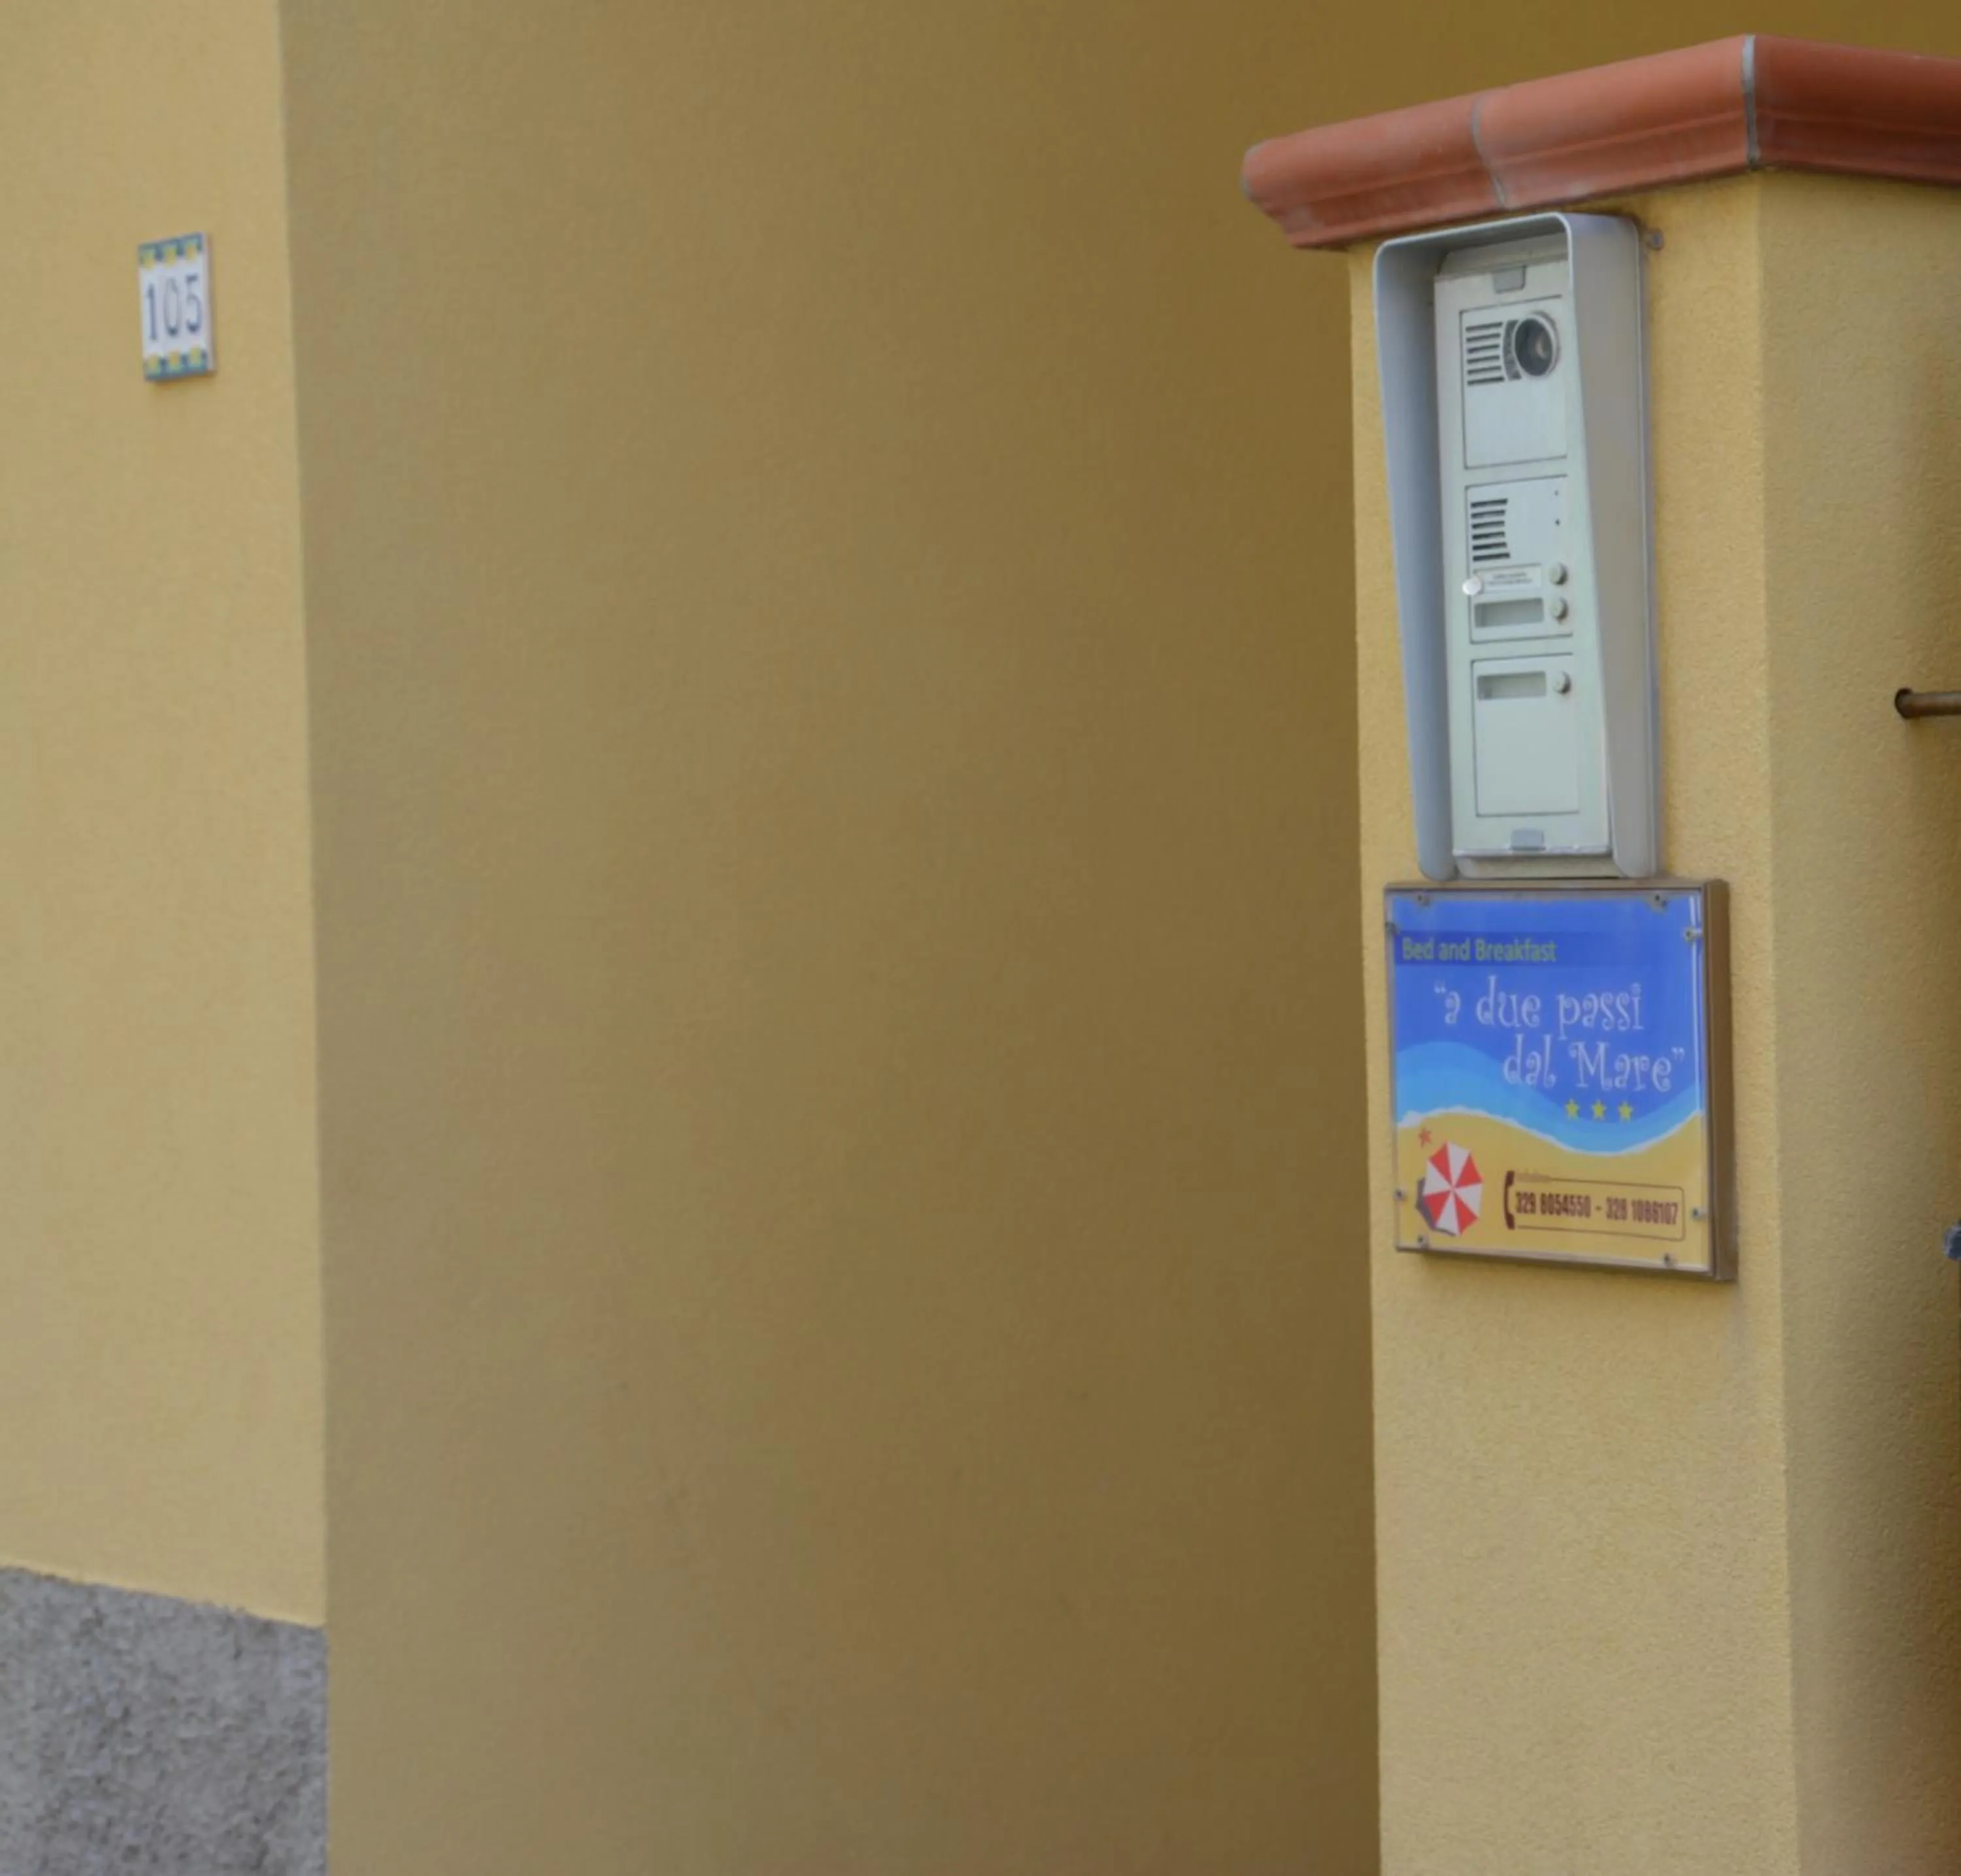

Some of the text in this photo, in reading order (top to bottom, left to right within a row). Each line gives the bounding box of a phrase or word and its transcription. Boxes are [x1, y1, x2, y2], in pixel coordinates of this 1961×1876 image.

[146, 273, 202, 341] 105
[1402, 937, 1557, 963] Bed and Breakfast
[1476, 975, 1541, 1028] due
[1557, 982, 1644, 1040] passi
[1503, 1033, 1556, 1088] dal
[1516, 1191, 1536, 1214] 329
